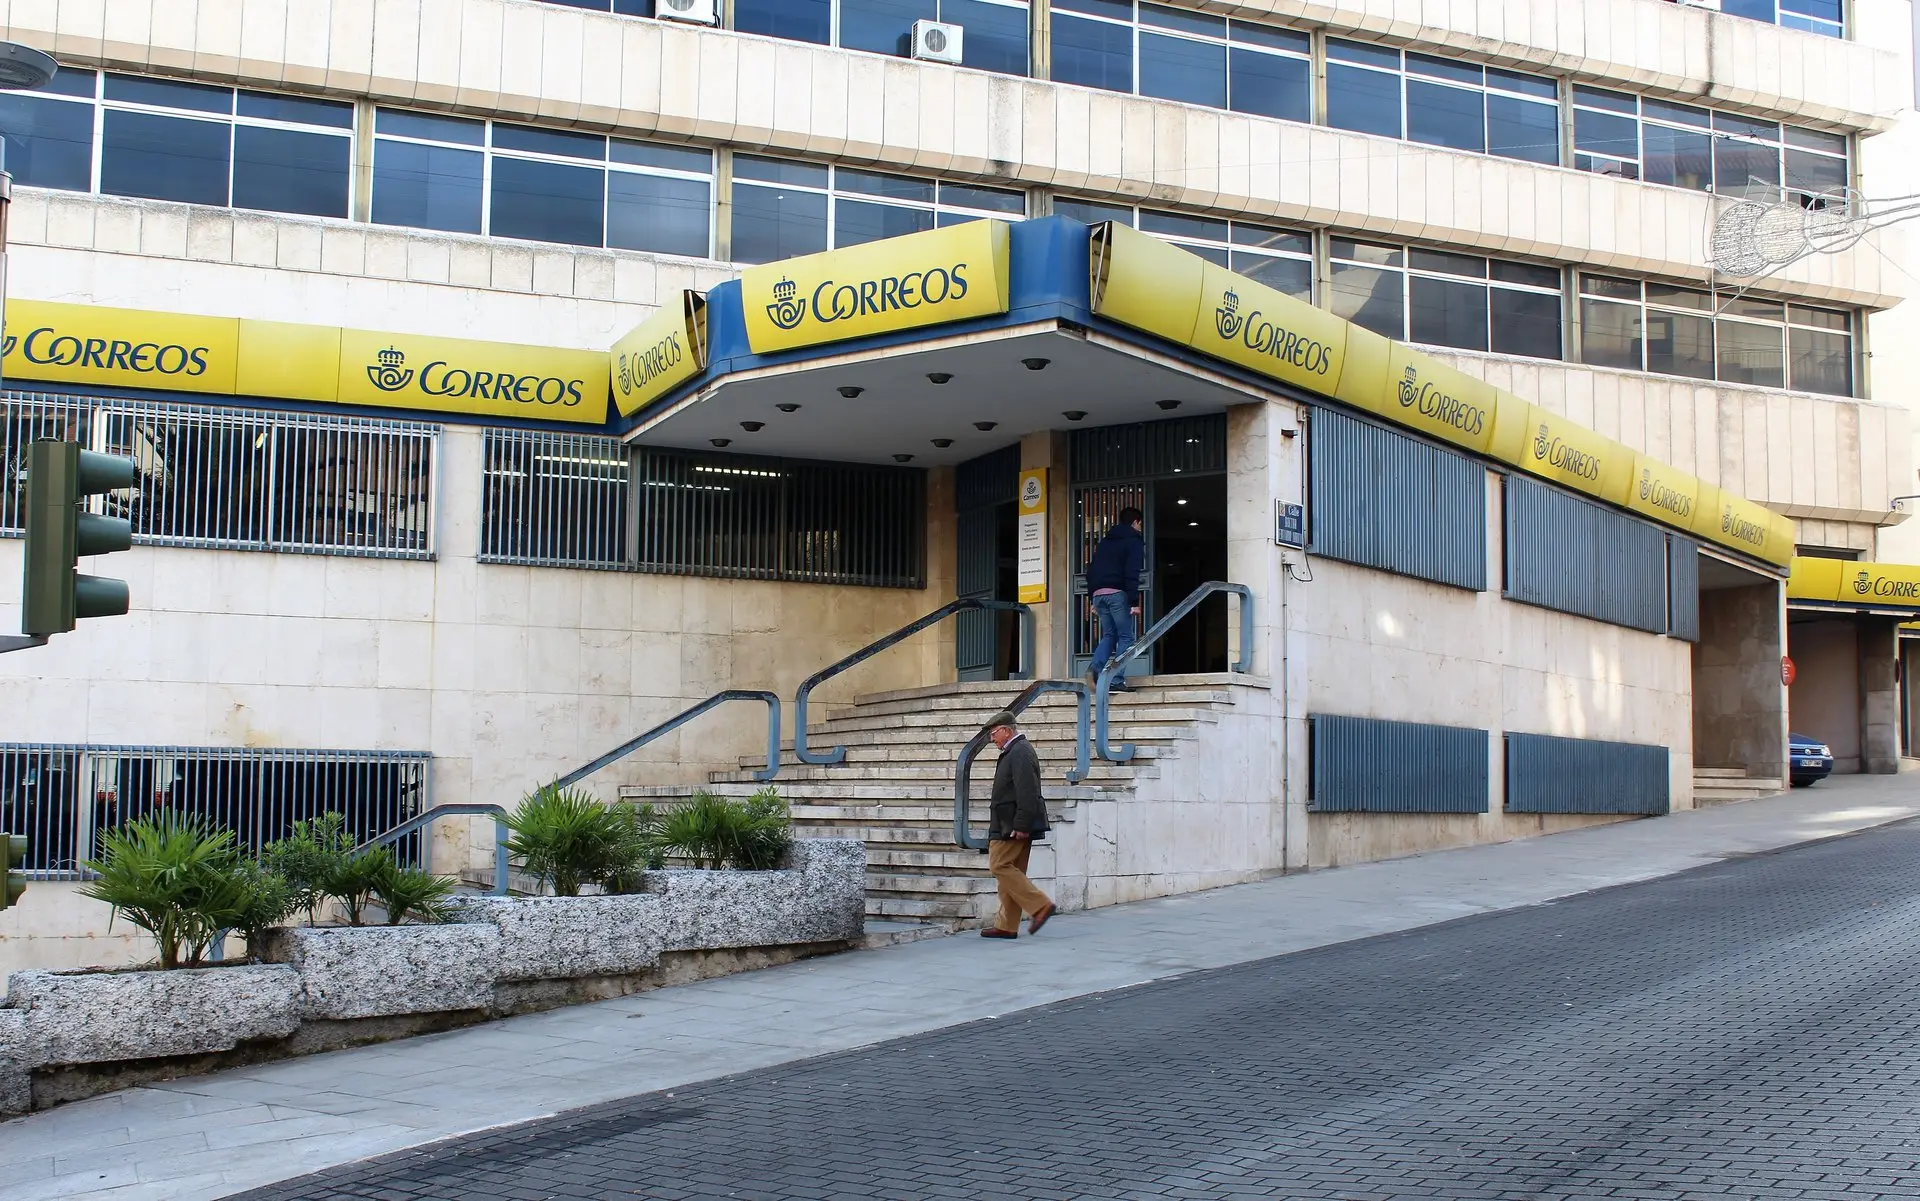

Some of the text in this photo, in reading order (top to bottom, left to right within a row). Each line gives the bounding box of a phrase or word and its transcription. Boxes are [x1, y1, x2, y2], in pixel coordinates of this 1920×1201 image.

[812, 263, 968, 323] CORREOS
[24, 327, 208, 376] CORREOS
[632, 330, 681, 388] CORREOS
[1244, 310, 1332, 375] CORREOS
[419, 361, 583, 407] CORREOS
[1419, 382, 1485, 435] CORREOS
[1549, 437, 1600, 481] CORREOS
[1651, 479, 1691, 518] CORREOS
[1732, 513, 1765, 546] CORREOS
